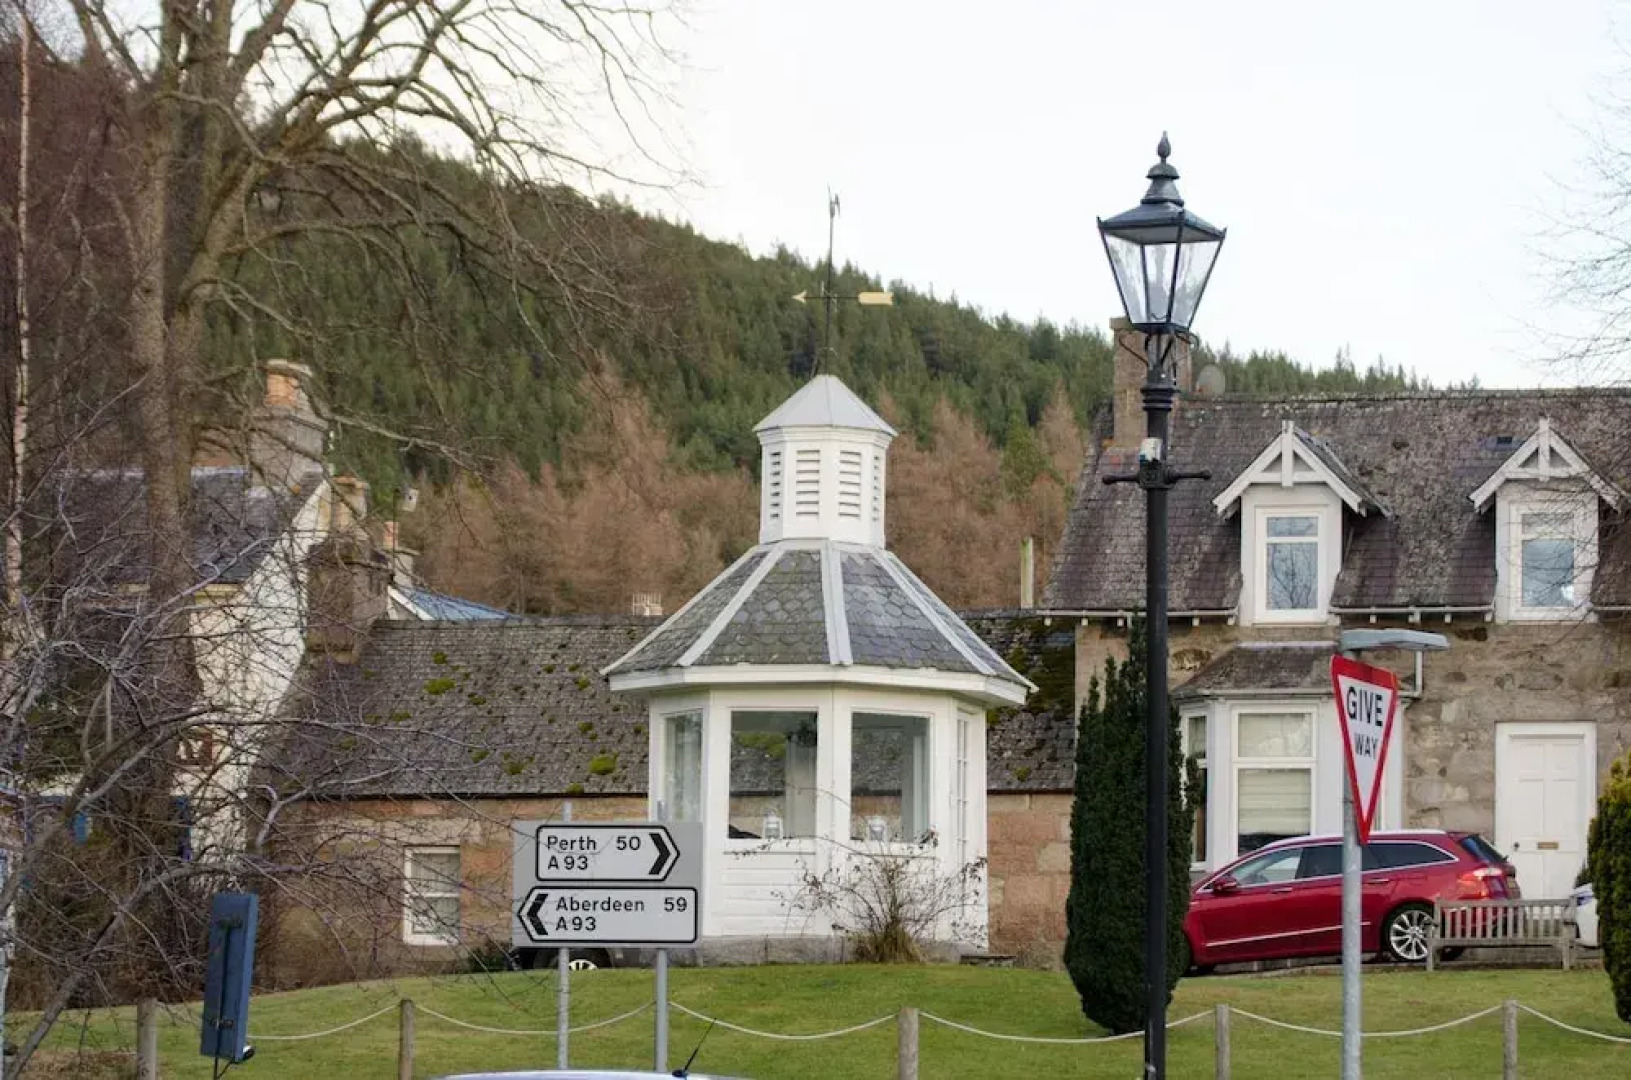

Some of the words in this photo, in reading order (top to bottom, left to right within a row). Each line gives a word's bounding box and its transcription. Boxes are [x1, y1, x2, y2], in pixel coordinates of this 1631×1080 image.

[1346, 686, 1383, 727] GIVE
[1354, 733, 1379, 760] WAY
[547, 836, 597, 851] Perth
[616, 836, 641, 851] 50
[547, 855, 589, 871] A93
[555, 896, 645, 912] Aberdeen
[663, 897, 688, 912] 59
[555, 916, 597, 931] A93
